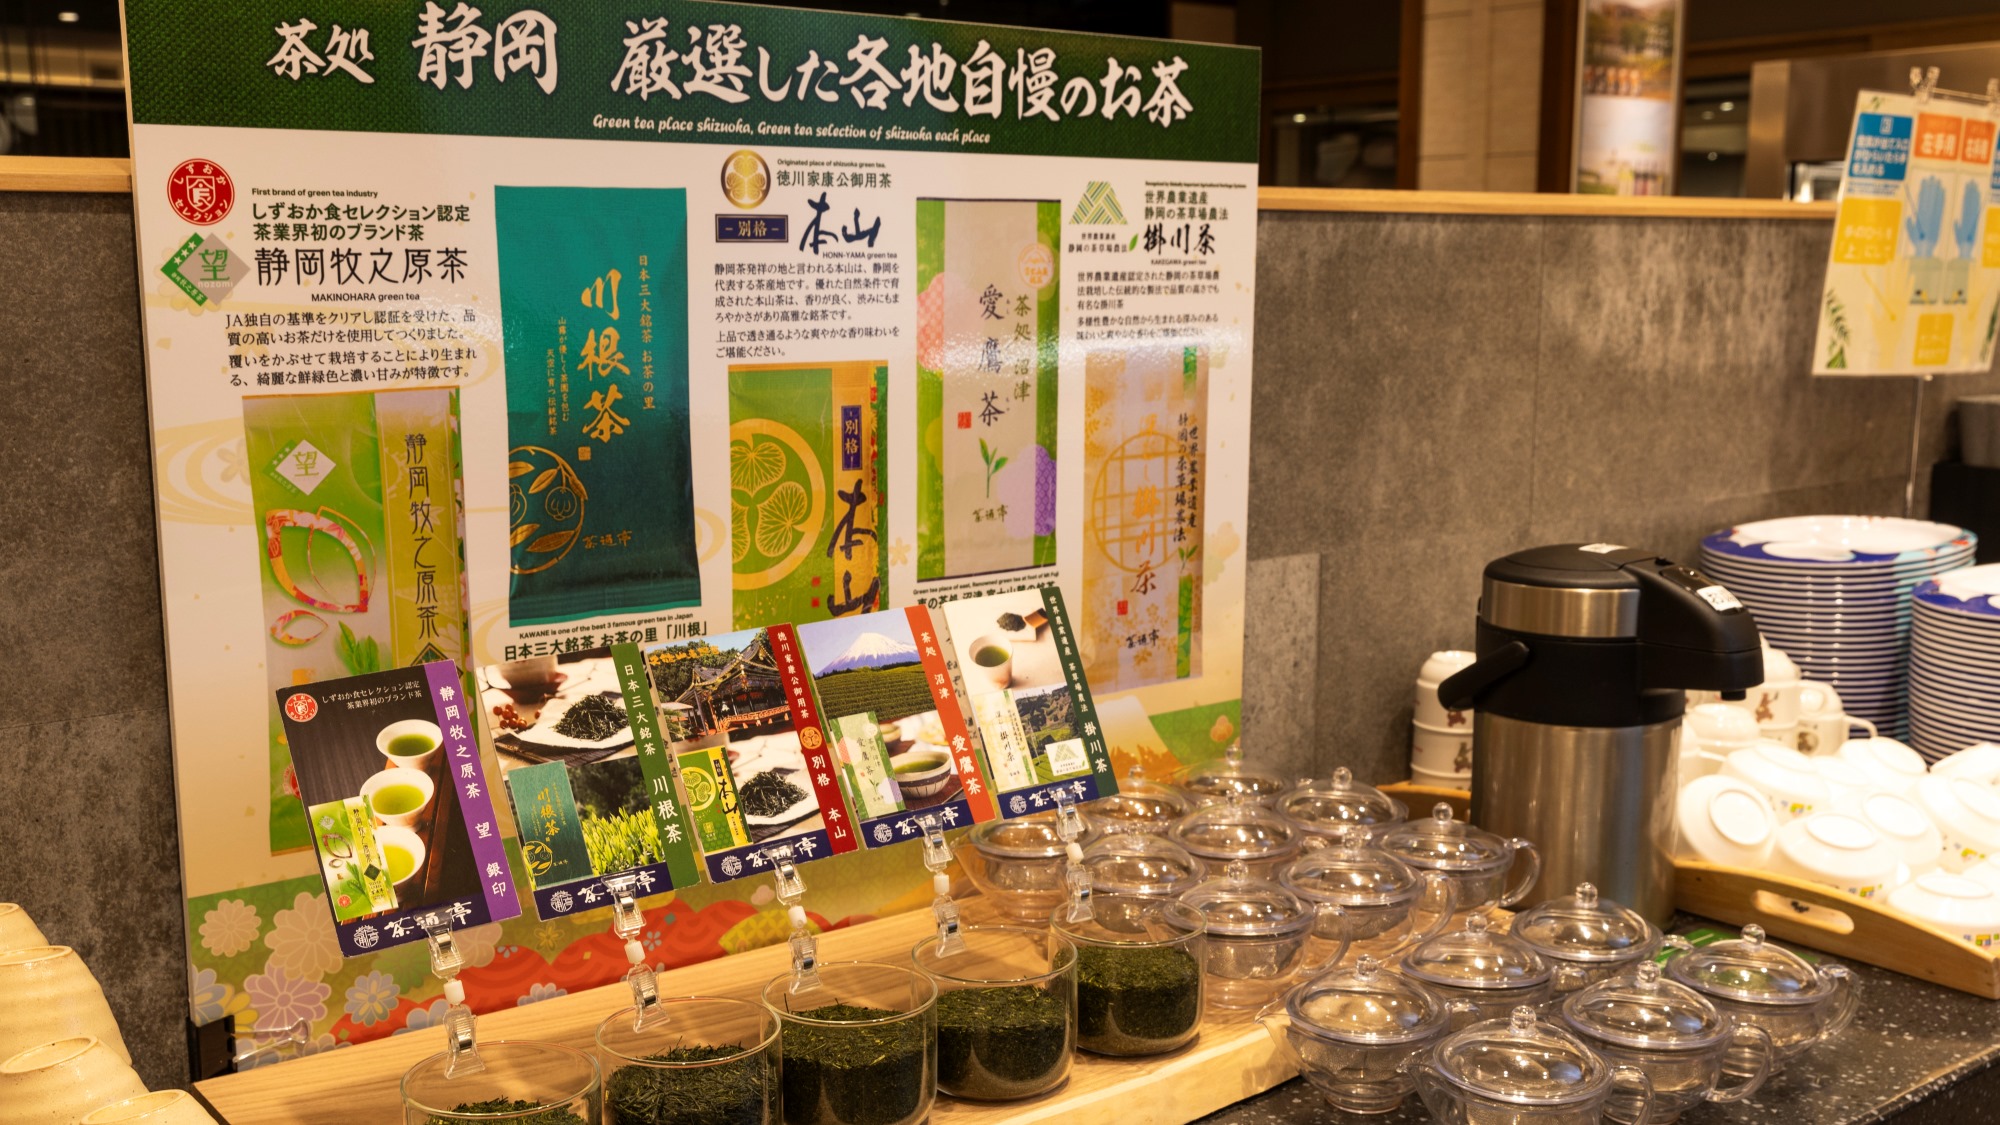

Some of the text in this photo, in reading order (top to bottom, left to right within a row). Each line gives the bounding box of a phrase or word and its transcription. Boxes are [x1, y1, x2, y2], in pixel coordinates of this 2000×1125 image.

[267, 2, 1194, 129] 茶処 静岡 厳選した各地自慢のお茶
[592, 113, 991, 146] Green tea place shizuoka, Green tea selection of shizuoka each place
[173, 162, 227, 186] しずおか
[776, 158, 808, 167] Originated
[809, 160, 825, 168] place
[834, 160, 858, 168] shizuoka
[776, 169, 892, 189] 徳川家康公御用茶
[251, 187, 378, 199] First brand of green tea industry
[1144, 190, 1208, 205] 世界農業遺産
[174, 197, 229, 223] セレクション
[252, 202, 471, 223] しずおか食セレクション認定
[1144, 206, 1228, 221] 静岡の茶草場農法
[253, 223, 424, 242] 茶業界初のブランド茶
[799, 191, 881, 256] 本山
[1143, 222, 1215, 256] 掛川茶
[198, 249, 230, 281] 望
[254, 246, 469, 287] 静岡牧之原茶
[822, 251, 865, 260] HONN-YAMA
[866, 253, 886, 261] green
[714, 262, 900, 277] 静岡茶発祥の地と言われる本山は、静岡を
[197, 281, 234, 289] nozomi
[714, 277, 900, 292] 代表する茶産地です。優れた自然条件で育
[311, 292, 420, 303] MAKINOHARA green tea
[225, 308, 476, 330] JA独自の基準をクリアし認証を受けた、品
[715, 308, 853, 324] ろやかさがあり高雅な銘茶です。
[227, 328, 466, 347] 質の高いお茶だけを使用してつくりました。
[638, 255, 656, 410] 日本三大銘茶 お茶の里
[229, 347, 477, 369] 覆いをかぶせて栽培することにより生まれ
[577, 268, 631, 443] 川根茶
[716, 345, 786, 359] ご堪能ください。
[978, 284, 1005, 427] 愛鷹茶
[229, 366, 470, 388] る、綺麗な鮮緑色と濃い甘みが特徴です。
[293, 451, 319, 477] 望
[404, 433, 440, 640] 静岡牧之原茶
[826, 478, 880, 617] 本山
[519, 628, 550, 639] KAWANE
[551, 628, 556, 636] is
[558, 627, 571, 635] one
[572, 625, 579, 634] of
[580, 624, 590, 633] the
[591, 623, 606, 631] best
[612, 620, 636, 628] famous
[637, 617, 655, 627] green
[674, 613, 693, 621] Japan
[504, 635, 595, 661] 日本三大銘茶
[321, 680, 421, 705] しずおか食セレクション認定
[346, 690, 422, 710] 茶業界初のブランド茶
[921, 631, 983, 797] 茶処 沼津 愛鷹茶
[777, 631, 847, 840] 徳川家康公御用茶 別格 本山
[1084, 721, 1108, 773] 掛川茶
[624, 664, 657, 756] 日本三大銘茶
[652, 776, 683, 844] 川根茶
[439, 685, 507, 898] 静岡牧之原茶 望 銀印
